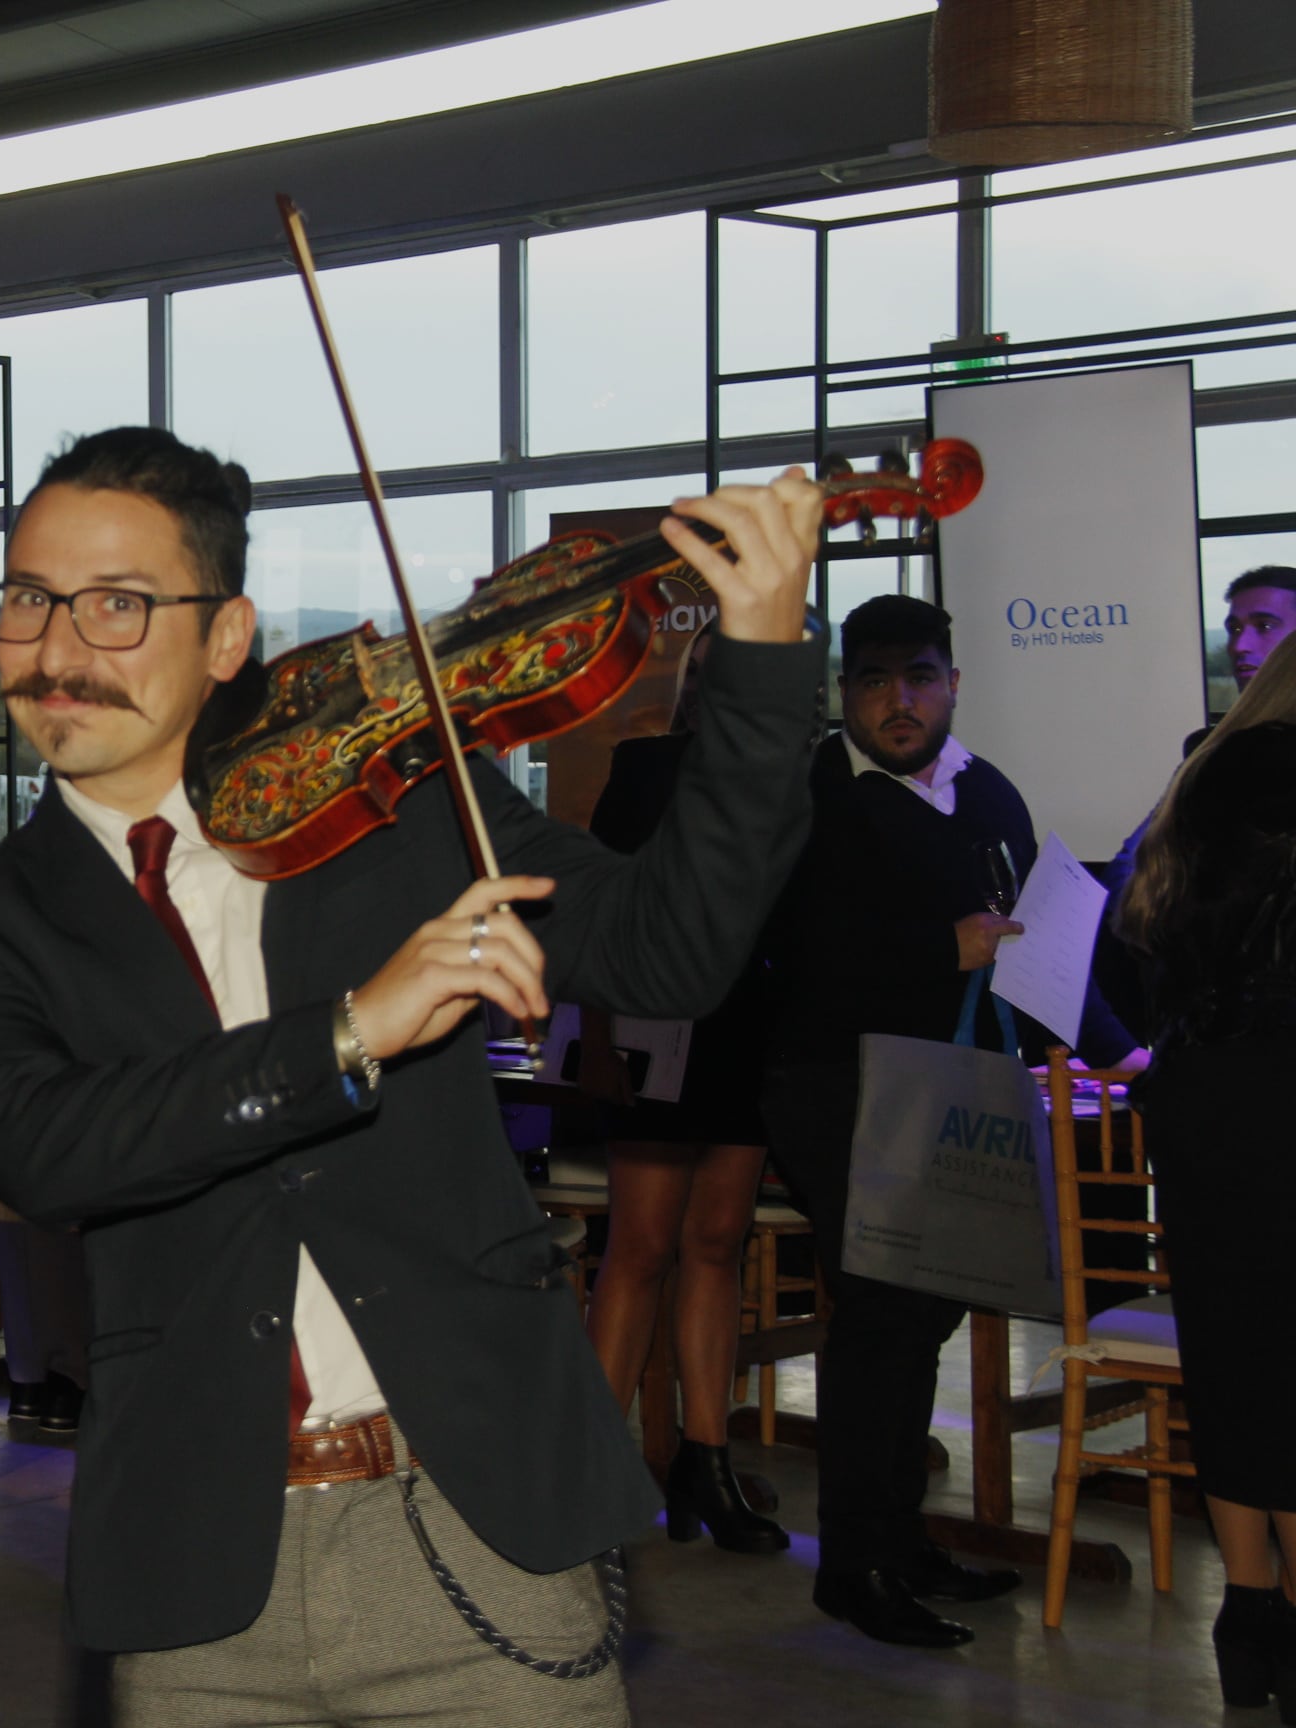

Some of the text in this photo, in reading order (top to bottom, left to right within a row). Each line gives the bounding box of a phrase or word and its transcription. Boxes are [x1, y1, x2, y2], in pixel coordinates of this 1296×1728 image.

[1006, 598, 1129, 630] Ocean
[1011, 631, 1104, 649] By H10 Hotels
[937, 1104, 1037, 1165] AVRIL
